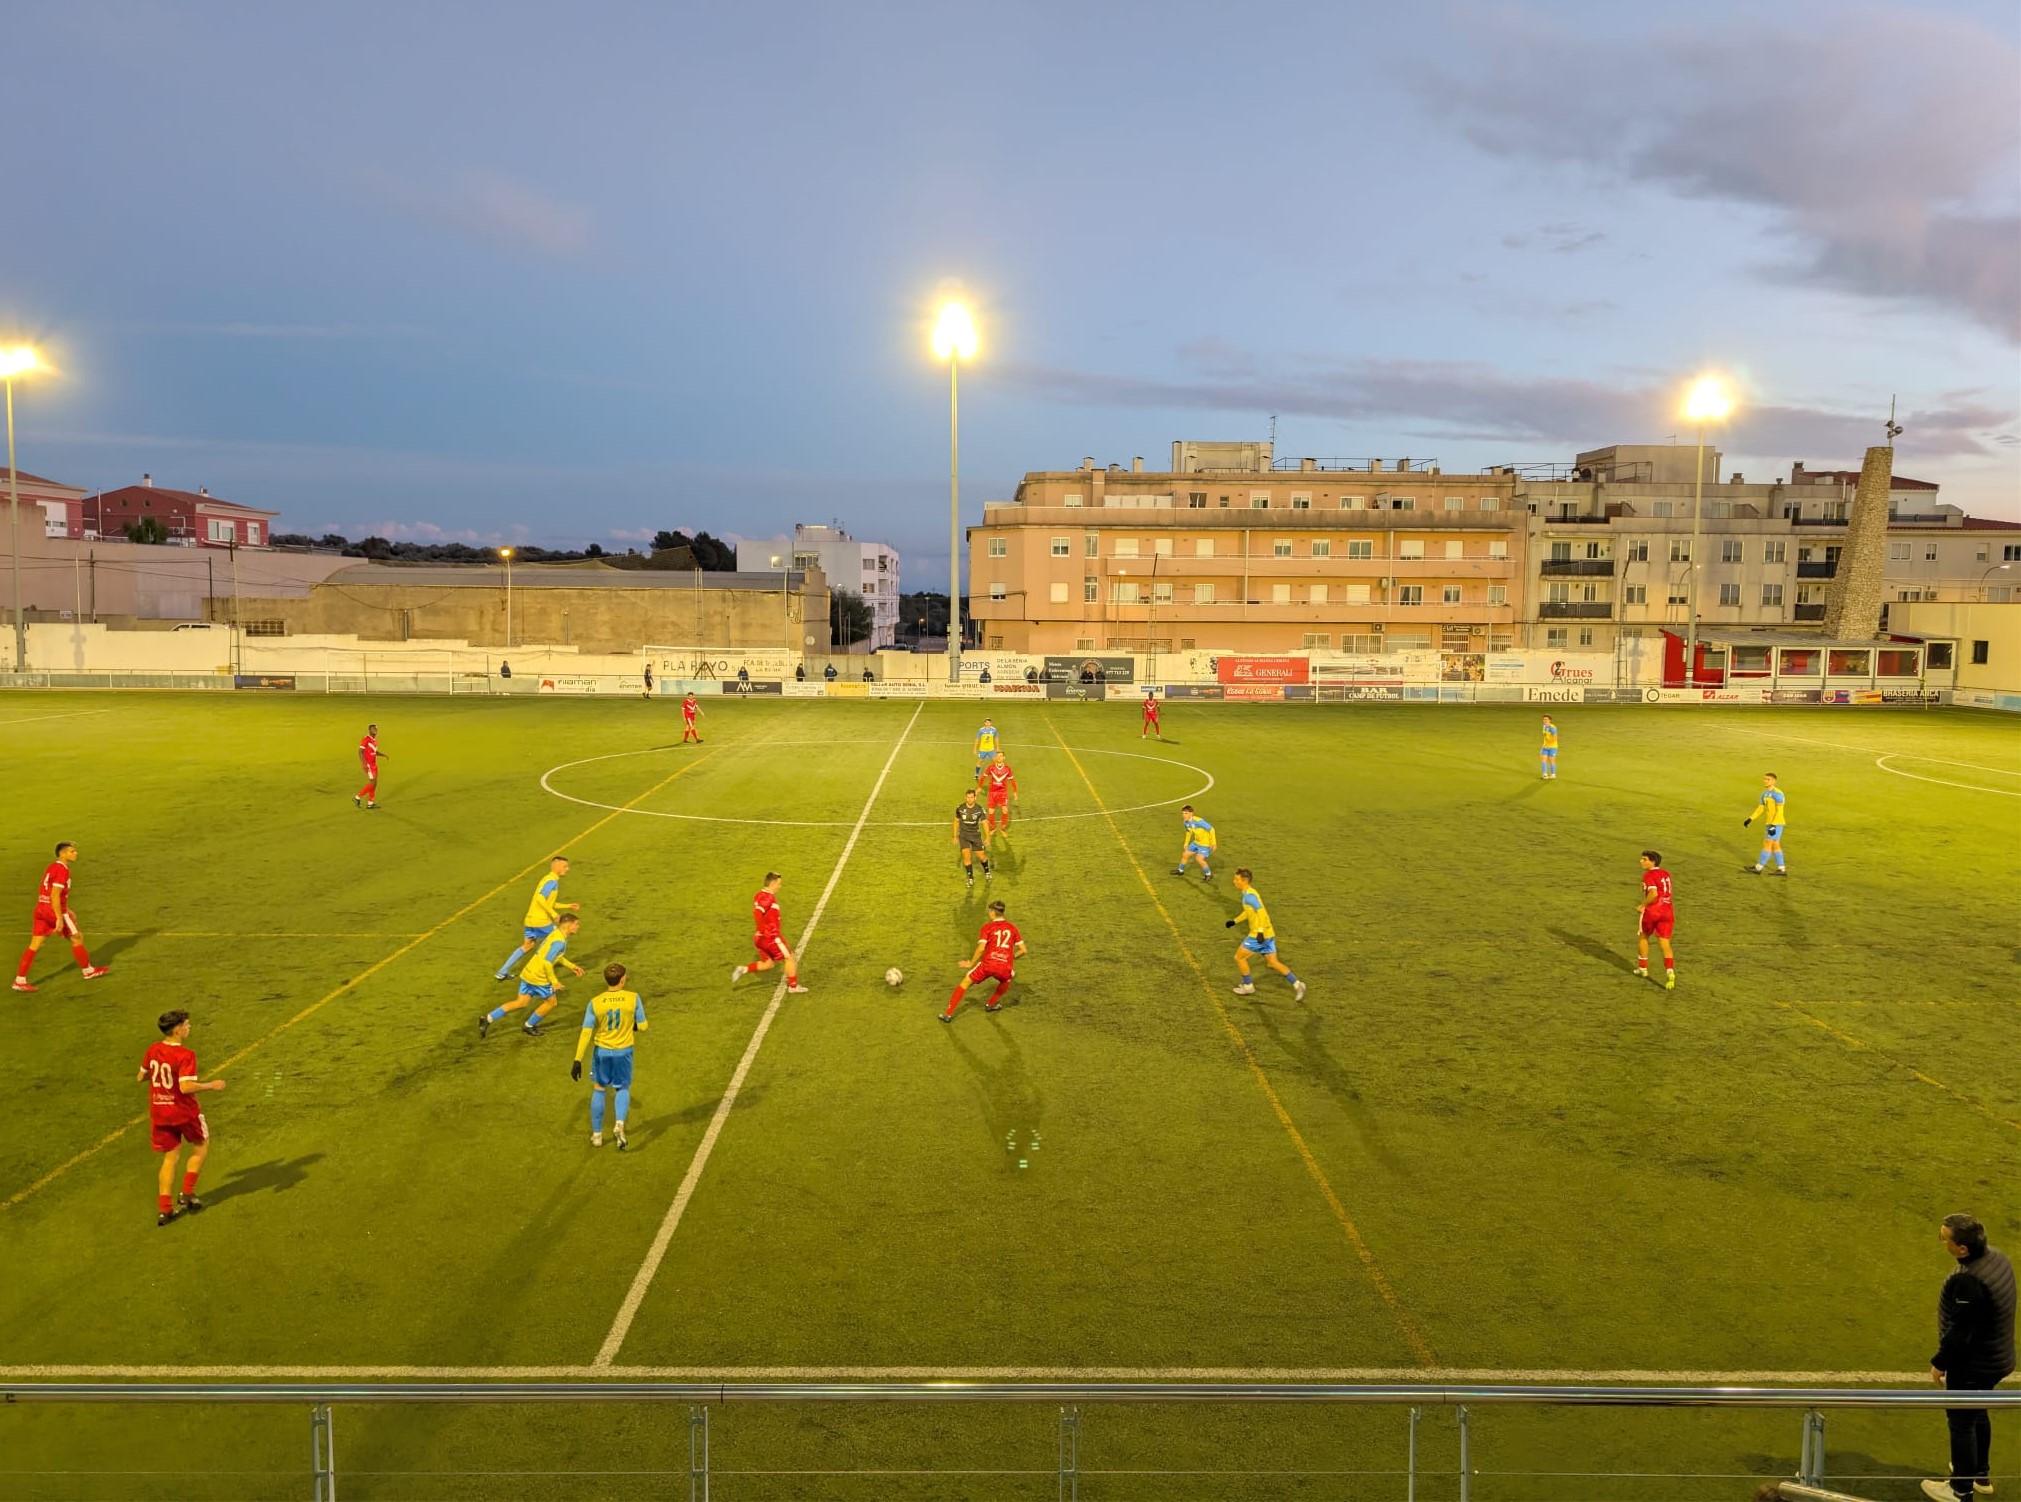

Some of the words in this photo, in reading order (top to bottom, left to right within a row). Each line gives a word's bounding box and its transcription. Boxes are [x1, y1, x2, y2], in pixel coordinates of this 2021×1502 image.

[663, 661, 685, 671] PLA
[1256, 668, 1293, 677] GENERALI
[1528, 687, 1579, 702] Emede
[994, 929, 1011, 948] 12
[606, 1008, 621, 1031] 11
[150, 1059, 173, 1090] 20
